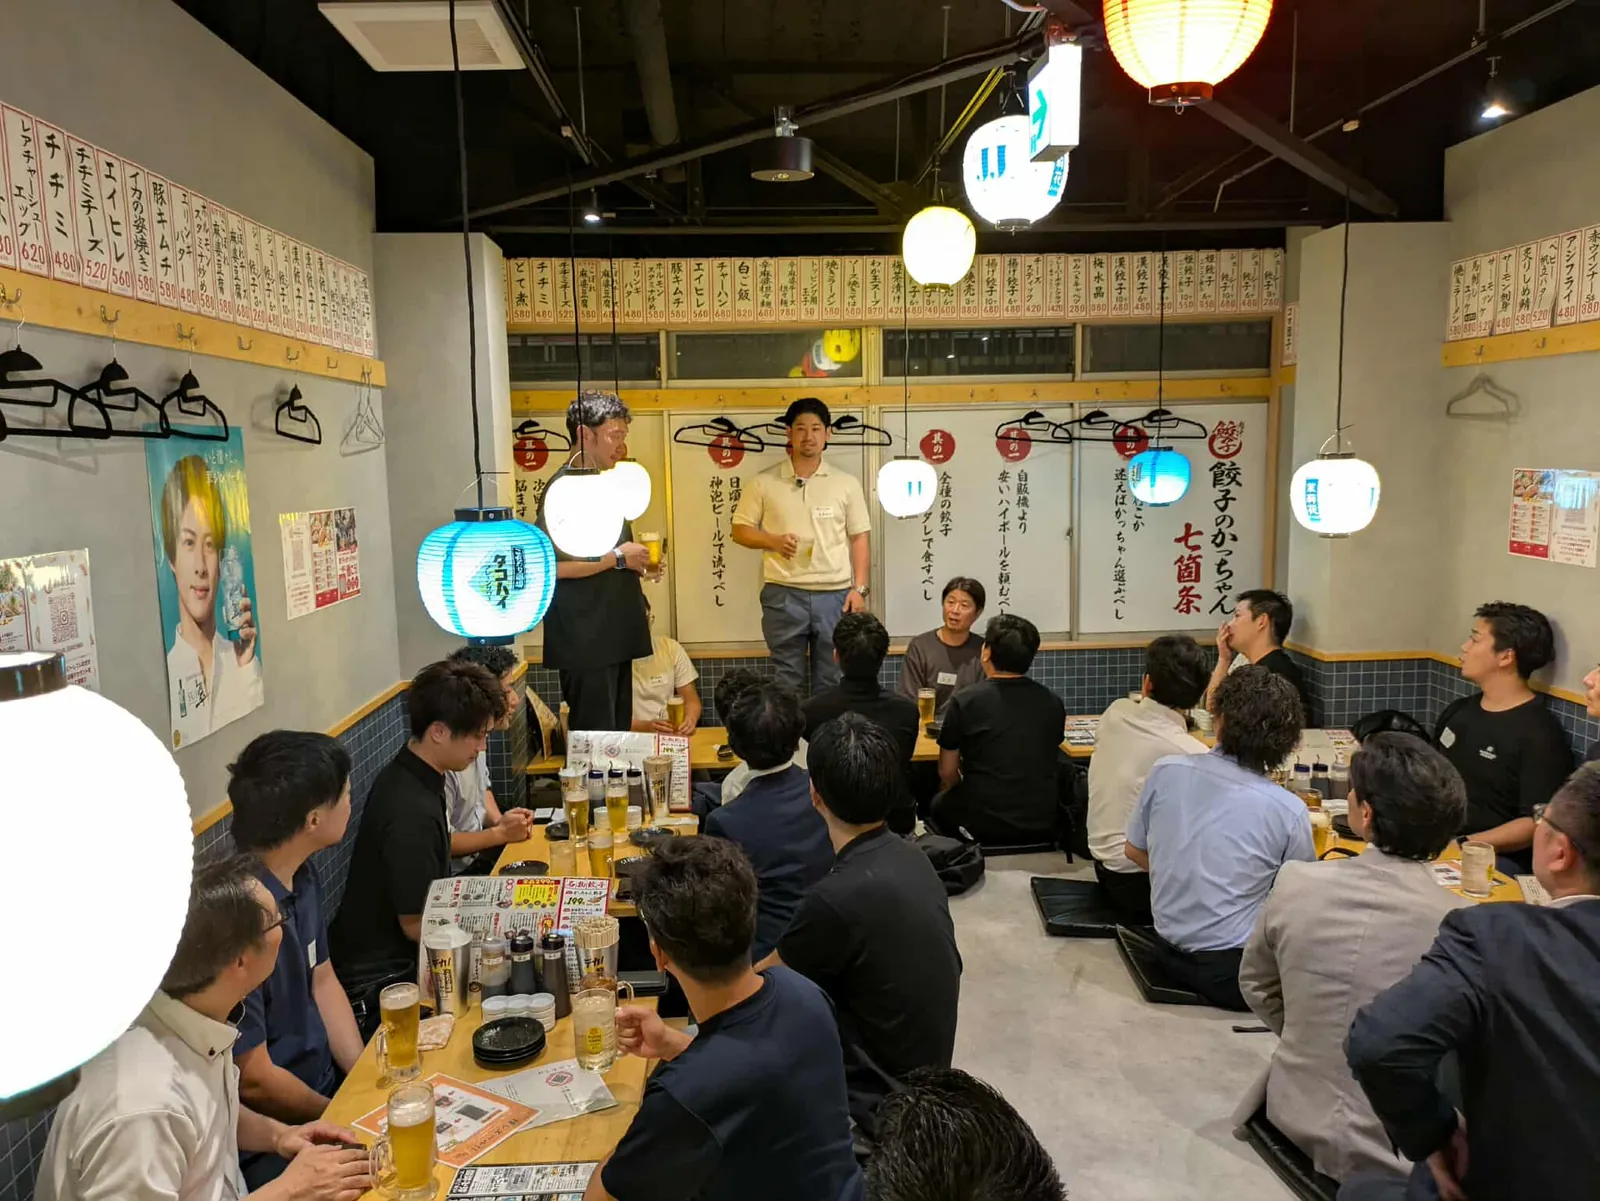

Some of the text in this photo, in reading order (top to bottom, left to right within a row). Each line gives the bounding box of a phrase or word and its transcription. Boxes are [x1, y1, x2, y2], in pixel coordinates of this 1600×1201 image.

[20, 118, 42, 242] レアチャーシュー
[13, 185, 31, 236] エッグ
[105, 160, 125, 263] エイヒレ
[129, 171, 150, 272] イカの姿焼き
[152, 181, 172, 277] 豚キムチ
[21, 242, 46, 265] 620
[54, 251, 76, 273] 480
[175, 231, 186, 282] バター
[1587, 229, 1600, 294] 赤ウインナー
[85, 260, 107, 281] 520
[111, 267, 131, 288] 560
[656, 262, 664, 297] ホルモン
[738, 261, 751, 301] 白ご飯
[825, 260, 838, 306] 焼きラーメン
[848, 259, 860, 307] ソース焼きそば
[891, 260, 902, 304] 梅茶漬け
[985, 258, 998, 296] 揚げ餃子
[1006, 258, 1019, 296] 揚げ餃子
[1034, 256, 1042, 285] チーズ
[1093, 257, 1105, 300] 梅水晶
[1115, 256, 1126, 295] 漢餃子
[1136, 256, 1148, 294] 漢餃子
[1487, 256, 1495, 304] サーモン
[1518, 247, 1532, 312] 炙りしめ鯖
[1563, 235, 1577, 303] アジフライ
[138, 274, 154, 293] 580
[159, 281, 176, 300] 580
[180, 288, 197, 306] 480
[515, 262, 528, 307] どて煮
[671, 262, 684, 309] 豚キムチ
[694, 262, 705, 308] エイヒレ
[717, 262, 728, 307] チャーハン
[1025, 264, 1034, 303] スティック
[1453, 264, 1464, 323] 焼きラーメン
[1498, 254, 1512, 313] サーモン刺身
[200, 296, 216, 312] 580
[219, 299, 233, 315] 580
[236, 303, 251, 320] 680
[514, 309, 531, 318] 580
[535, 309, 552, 318] 480
[558, 309, 574, 318] 520
[581, 309, 597, 318] 580
[624, 310, 641, 318] 480
[648, 310, 664, 318] 580
[671, 310, 687, 318] 580
[693, 310, 708, 318] 560
[715, 310, 731, 318] 680
[759, 308, 774, 317] 680
[780, 308, 796, 316] 780
[805, 308, 815, 316] 50
[825, 308, 840, 316] 580
[845, 307, 861, 316] 580
[983, 305, 999, 314] 680
[1005, 305, 1020, 313] 480
[1026, 304, 1042, 313] 420
[1069, 305, 1085, 313] 280
[1112, 303, 1129, 311] 680
[1135, 302, 1151, 311] 480
[1532, 310, 1548, 321] 520
[1557, 306, 1575, 318] 480
[1581, 301, 1600, 315] 380
[1515, 313, 1530, 326] 580
[931, 432, 944, 459] 其の一
[939, 471, 952, 537] 全種の餃子
[1016, 469, 1029, 534] 自販機より
[710, 476, 726, 607] 神泡ビールで流すべし
[1113, 467, 1128, 620] 迷えばかっちゃん選ぶべし
[1208, 461, 1243, 615] 餃子のかっちゃん
[493, 554, 510, 609] タコハイ
[1173, 522, 1204, 615] 七箇条
